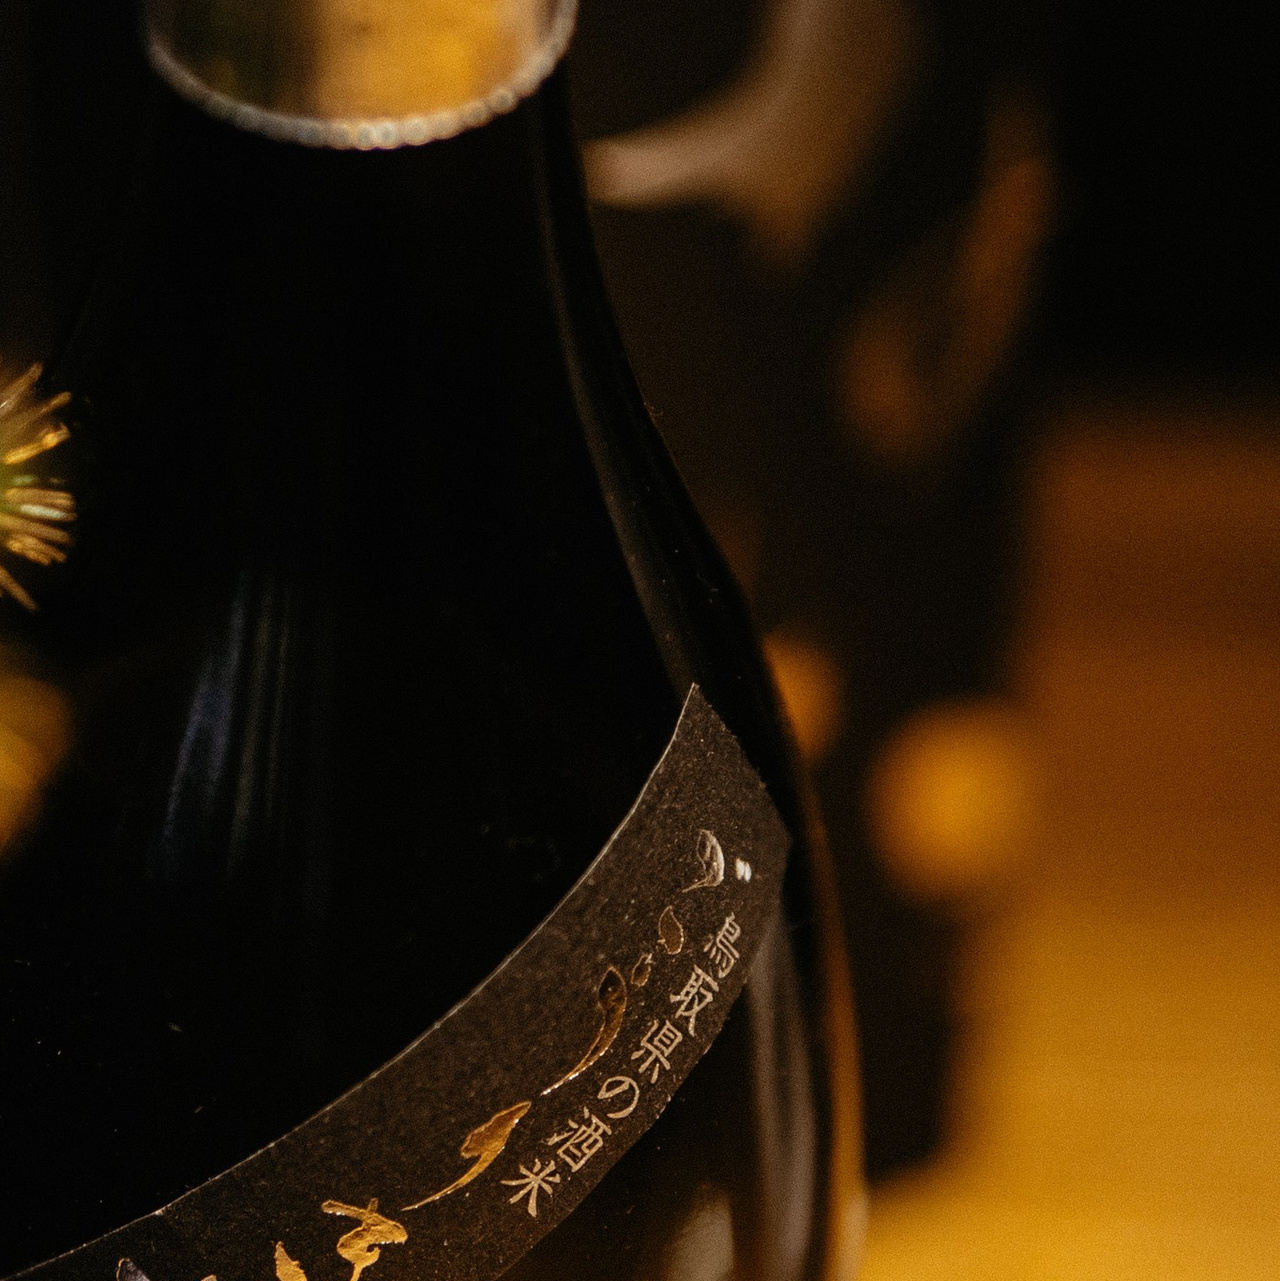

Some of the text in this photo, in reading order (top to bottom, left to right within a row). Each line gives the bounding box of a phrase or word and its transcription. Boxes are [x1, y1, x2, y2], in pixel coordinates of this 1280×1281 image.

[500, 911, 741, 1218] 鳥取県の酒米
